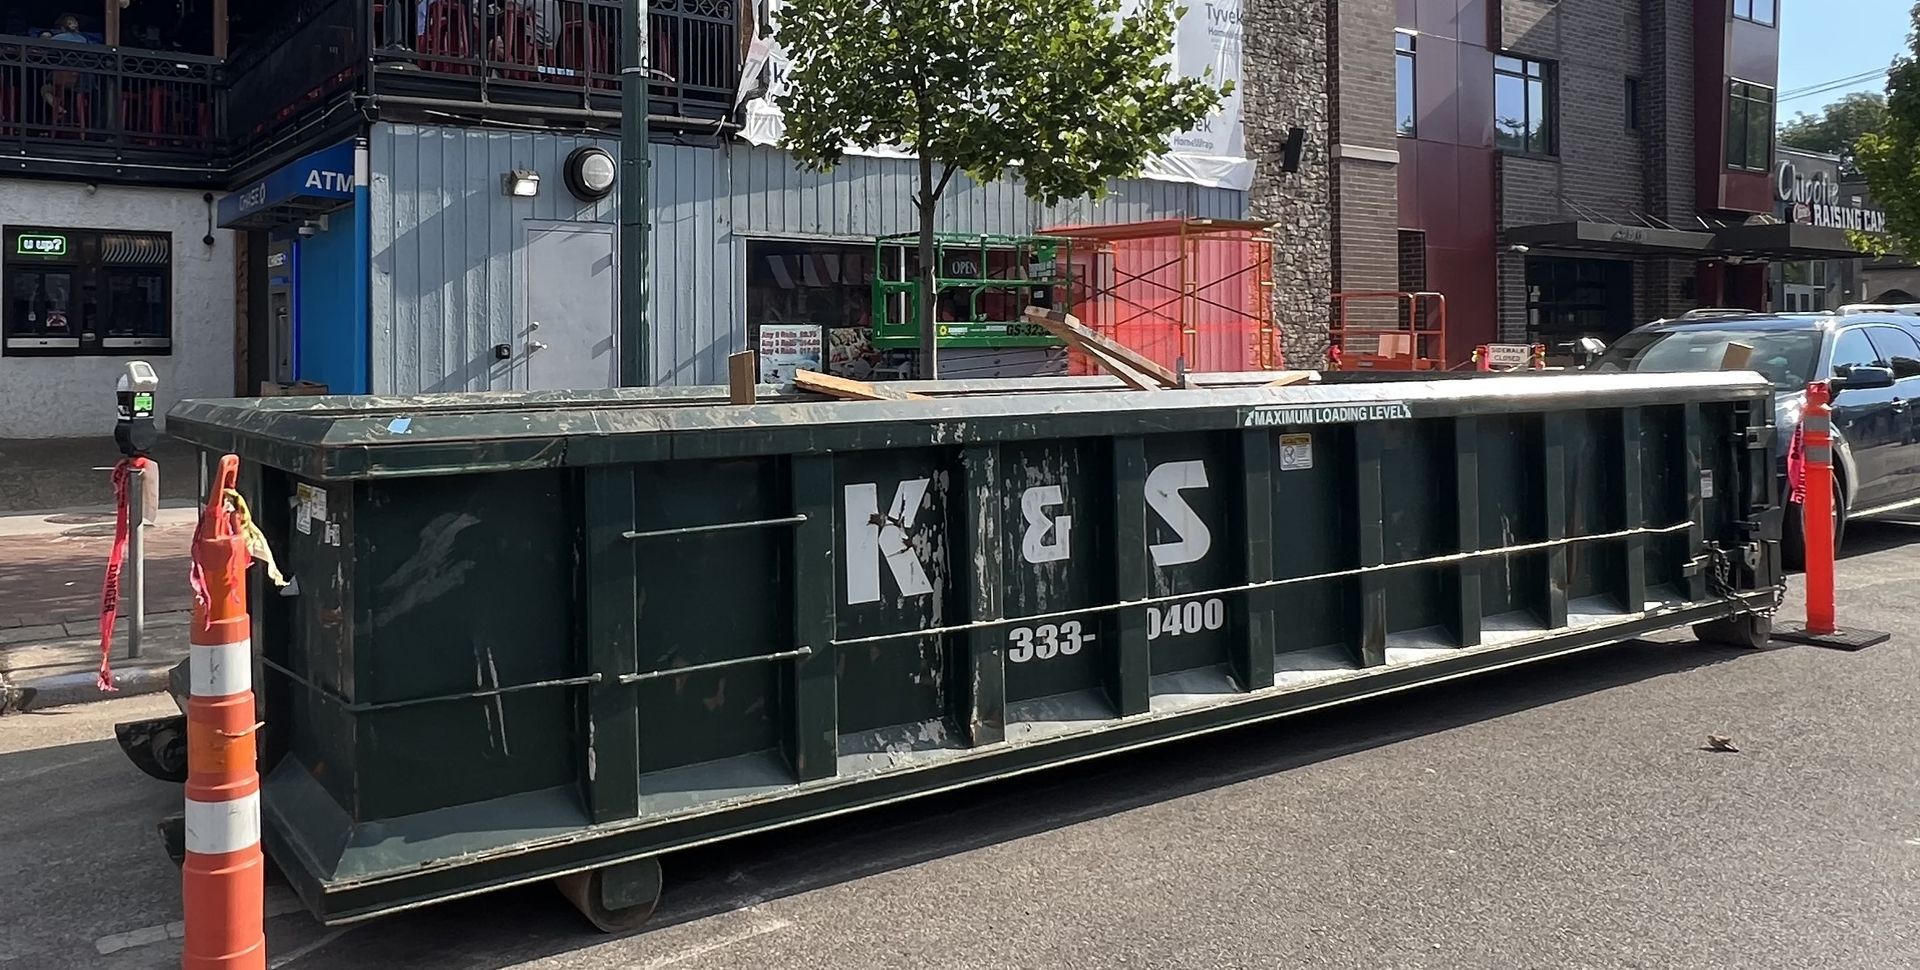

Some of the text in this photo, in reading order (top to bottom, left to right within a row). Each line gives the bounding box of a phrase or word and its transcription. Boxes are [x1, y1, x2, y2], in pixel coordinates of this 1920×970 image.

[1205, 3, 1243, 25] Tyvek
[305, 169, 355, 193] ATM
[1778, 159, 1840, 206] Chipotle
[1814, 203, 1862, 231] RAISING
[23, 239, 62, 252] u up?
[952, 260, 977, 275] OPEN
[1254, 405, 1404, 426] MAXIMUM LOADING LEVEL
[844, 460, 1211, 605] K & S
[103, 564, 118, 613] DANGER
